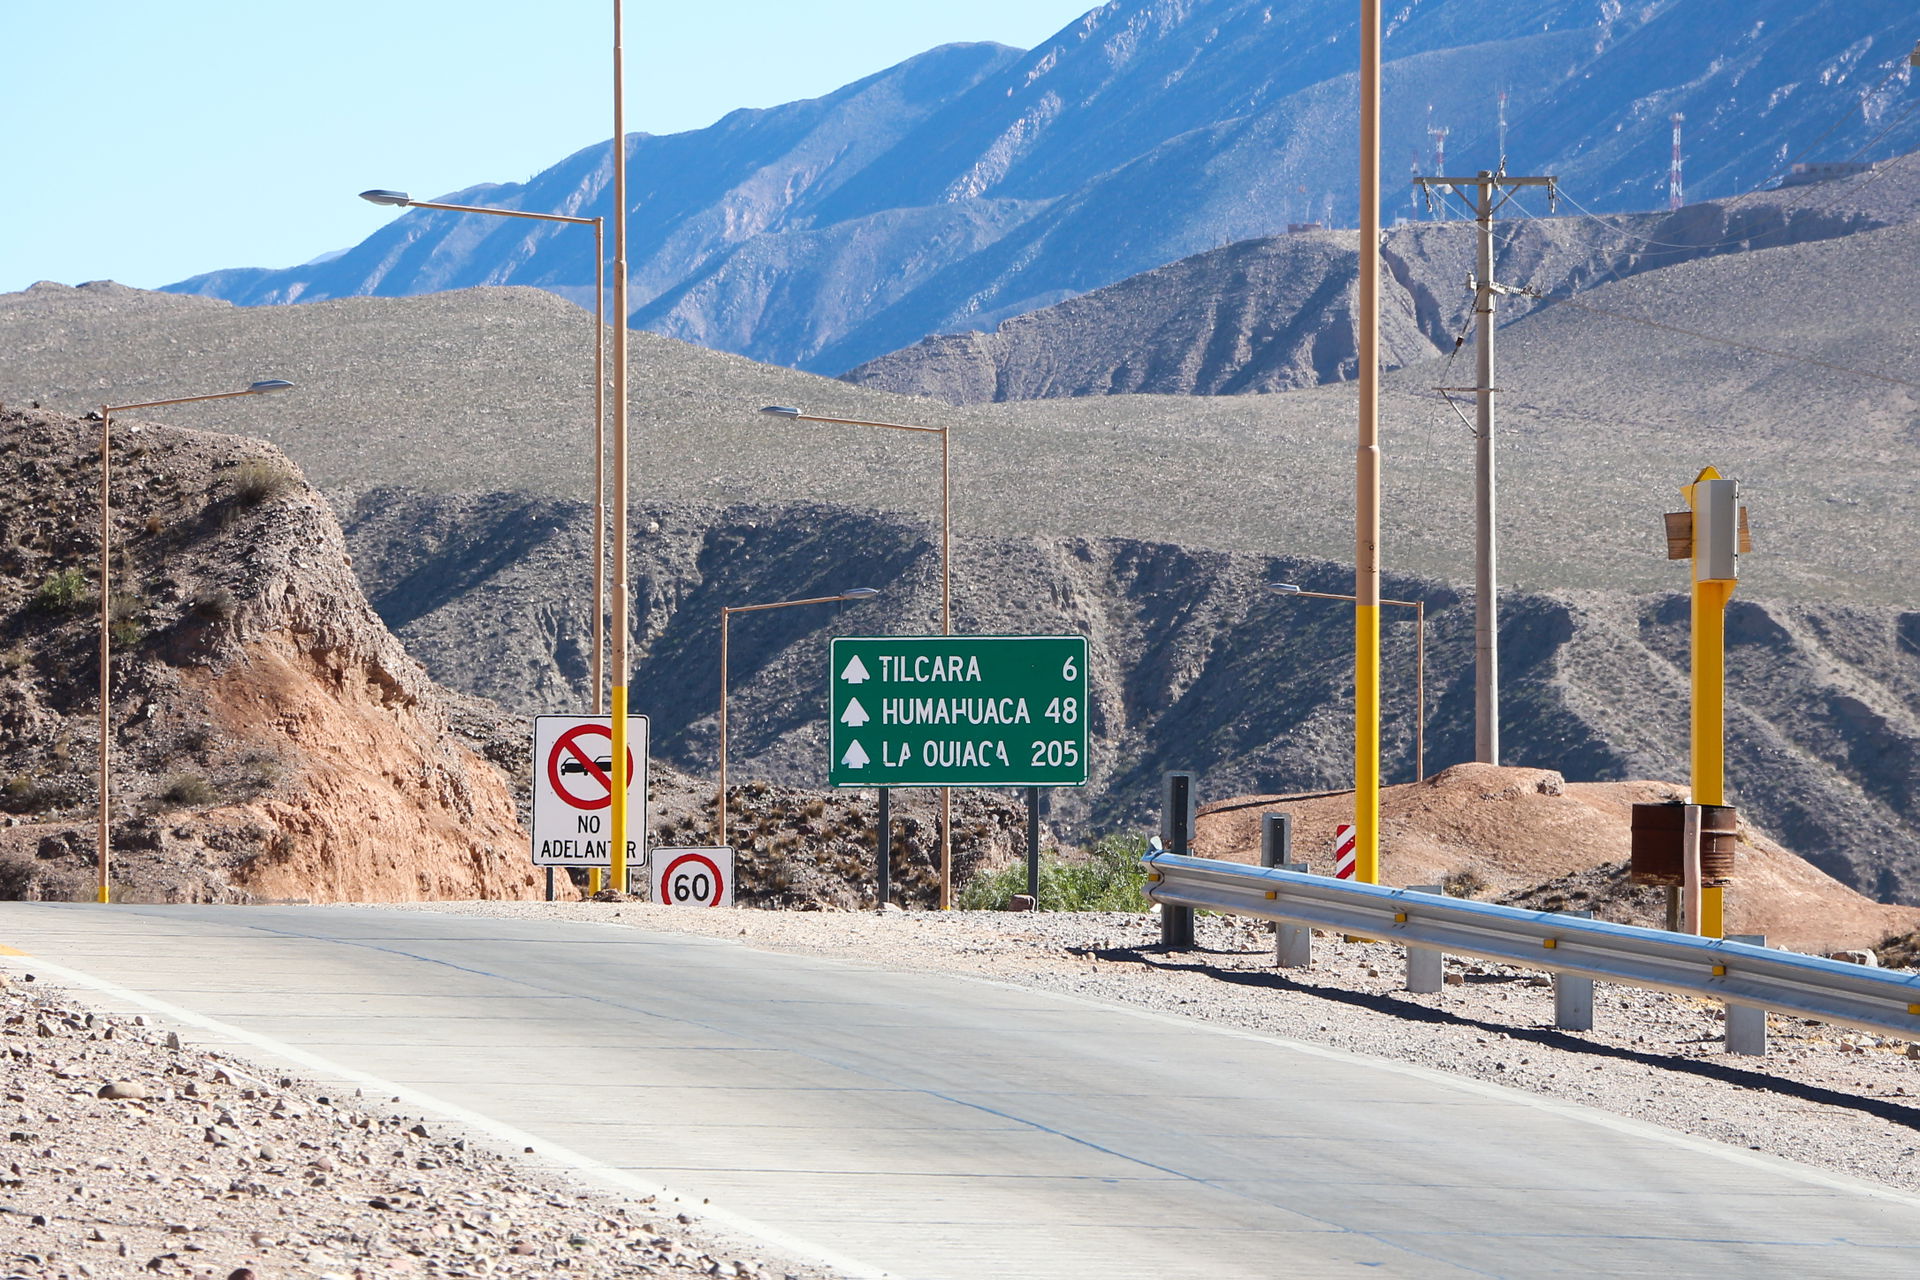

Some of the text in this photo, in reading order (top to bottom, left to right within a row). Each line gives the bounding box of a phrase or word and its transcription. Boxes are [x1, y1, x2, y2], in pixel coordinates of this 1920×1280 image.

[879, 655, 1078, 682] TILCARA 6
[882, 697, 1078, 725] HUMAHUACA 48
[882, 741, 912, 768] LA
[1030, 740, 1079, 768] 205
[577, 814, 601, 834] NO
[540, 839, 637, 859] ADELANR
[673, 873, 710, 902] 60
